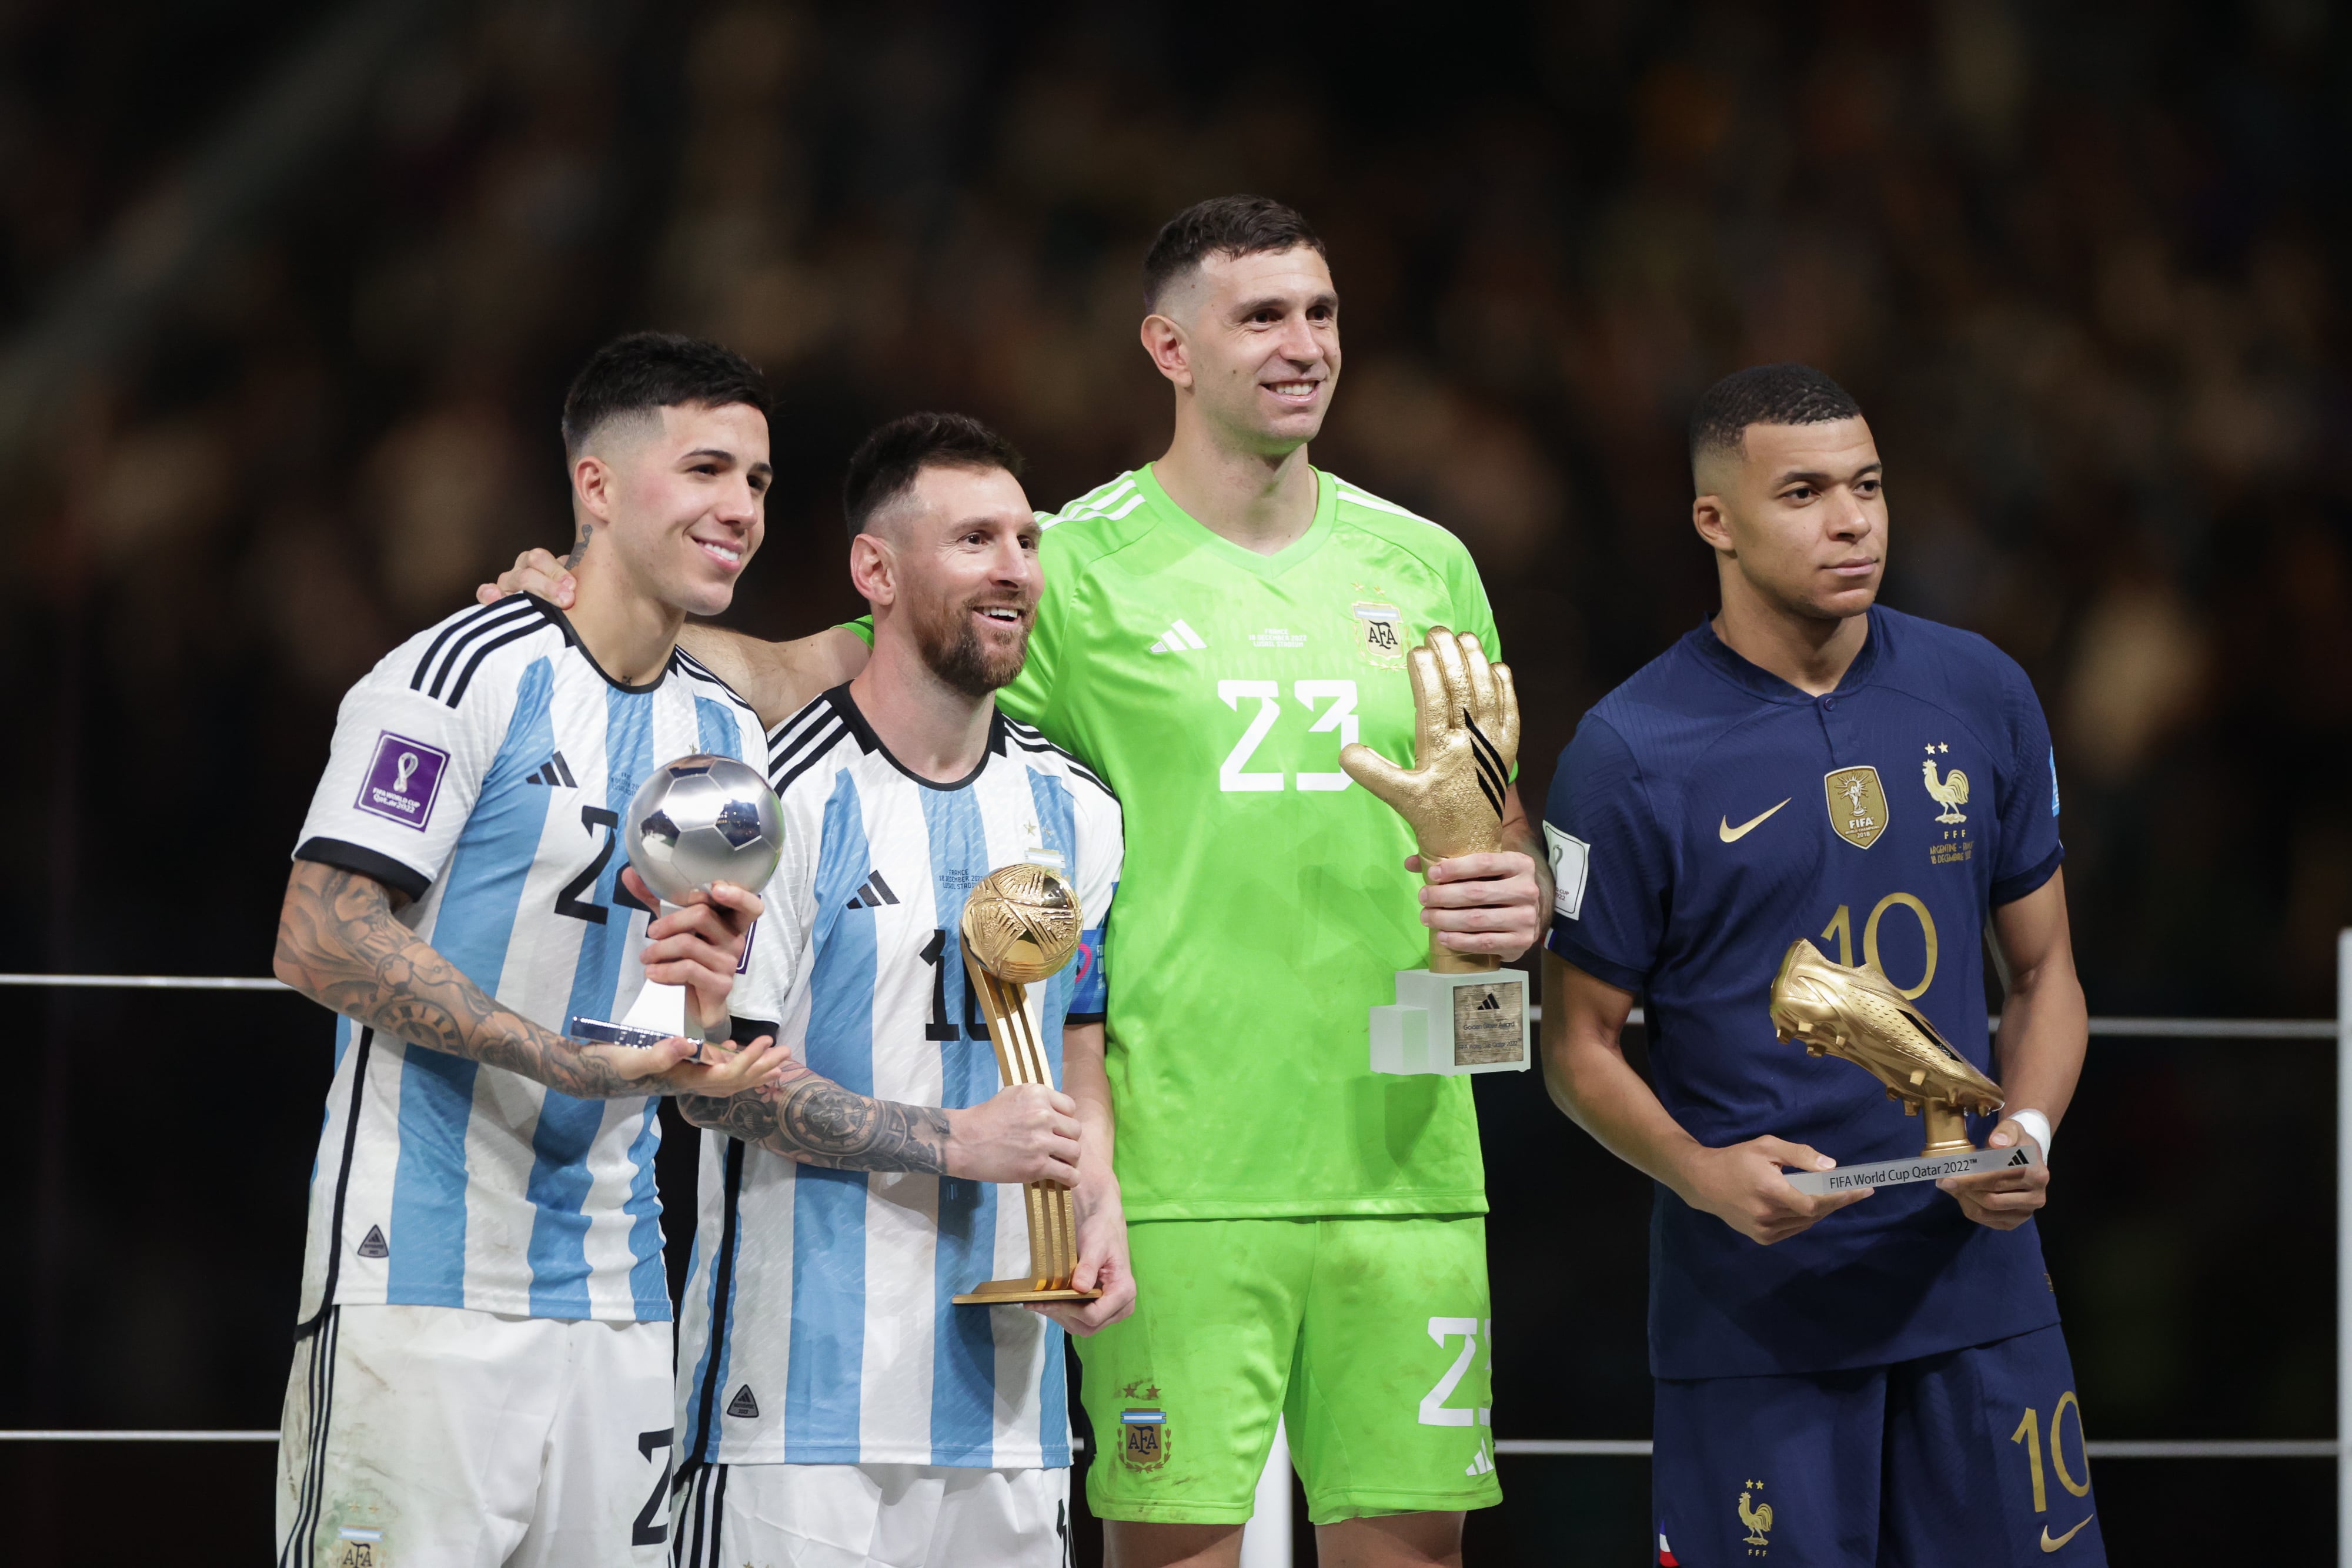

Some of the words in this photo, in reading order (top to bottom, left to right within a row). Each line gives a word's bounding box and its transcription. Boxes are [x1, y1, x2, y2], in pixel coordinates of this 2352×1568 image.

[1368, 620, 1398, 649] AFA
[1217, 680, 1359, 791] 23
[1849, 817, 1874, 829] FIFA
[1820, 892, 1937, 1000] 10
[1830, 1176, 1853, 1189] FIFA
[1853, 1171, 1886, 1185] World
[1888, 1169, 1910, 1182] Cup
[1912, 1166, 1942, 1178] Qatar
[1418, 1316, 1491, 1427] 2
[1128, 1425, 1158, 1455] AFA
[2010, 1391, 2090, 1513] 10
[343, 1541, 372, 1568] AFA
